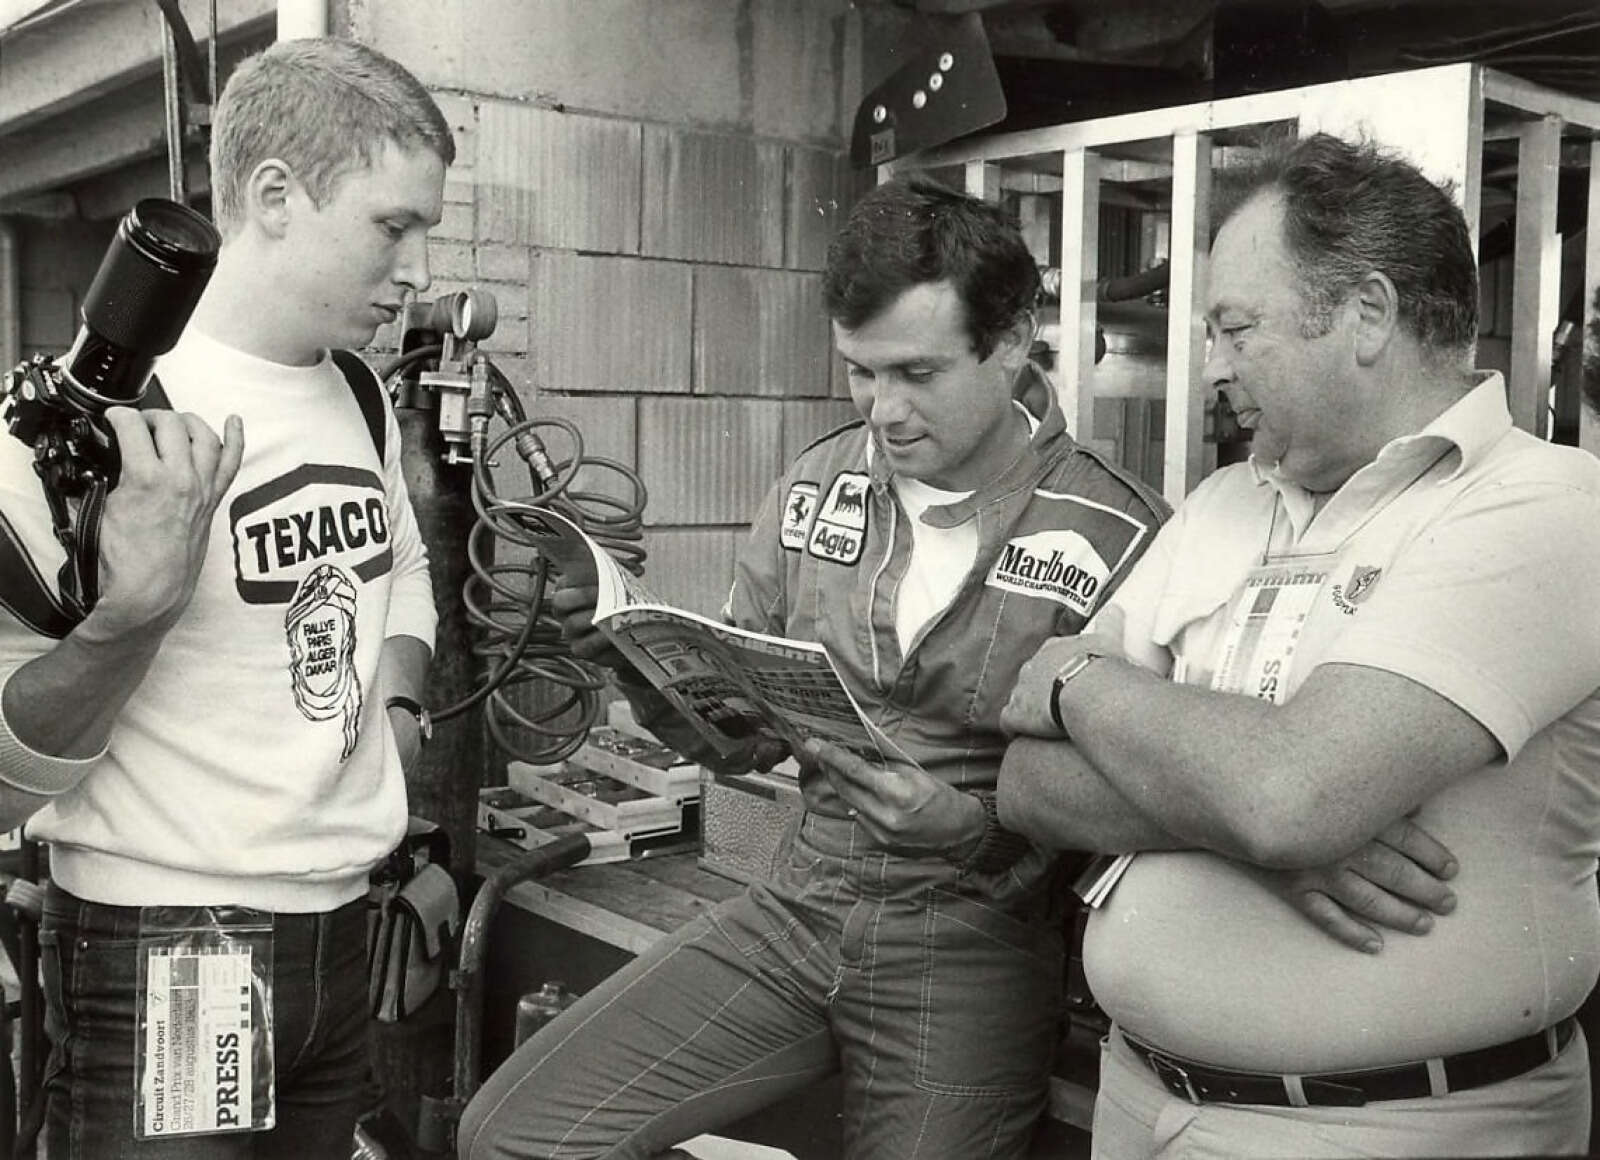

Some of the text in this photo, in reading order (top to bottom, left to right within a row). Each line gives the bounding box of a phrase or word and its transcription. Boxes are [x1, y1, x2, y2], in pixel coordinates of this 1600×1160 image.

[246, 498, 387, 574] TEXACO
[814, 525, 857, 558] Agip
[996, 572, 1024, 586] WORLD
[998, 543, 1098, 599] Marlboro
[303, 619, 336, 636] RALLYE
[306, 634, 332, 648] PARIS
[306, 647, 337, 663] ALGER
[304, 660, 338, 677] DAKAR
[152, 1020, 166, 1132] Circuit Zandvoort
[216, 1032, 239, 1128] PRESS
